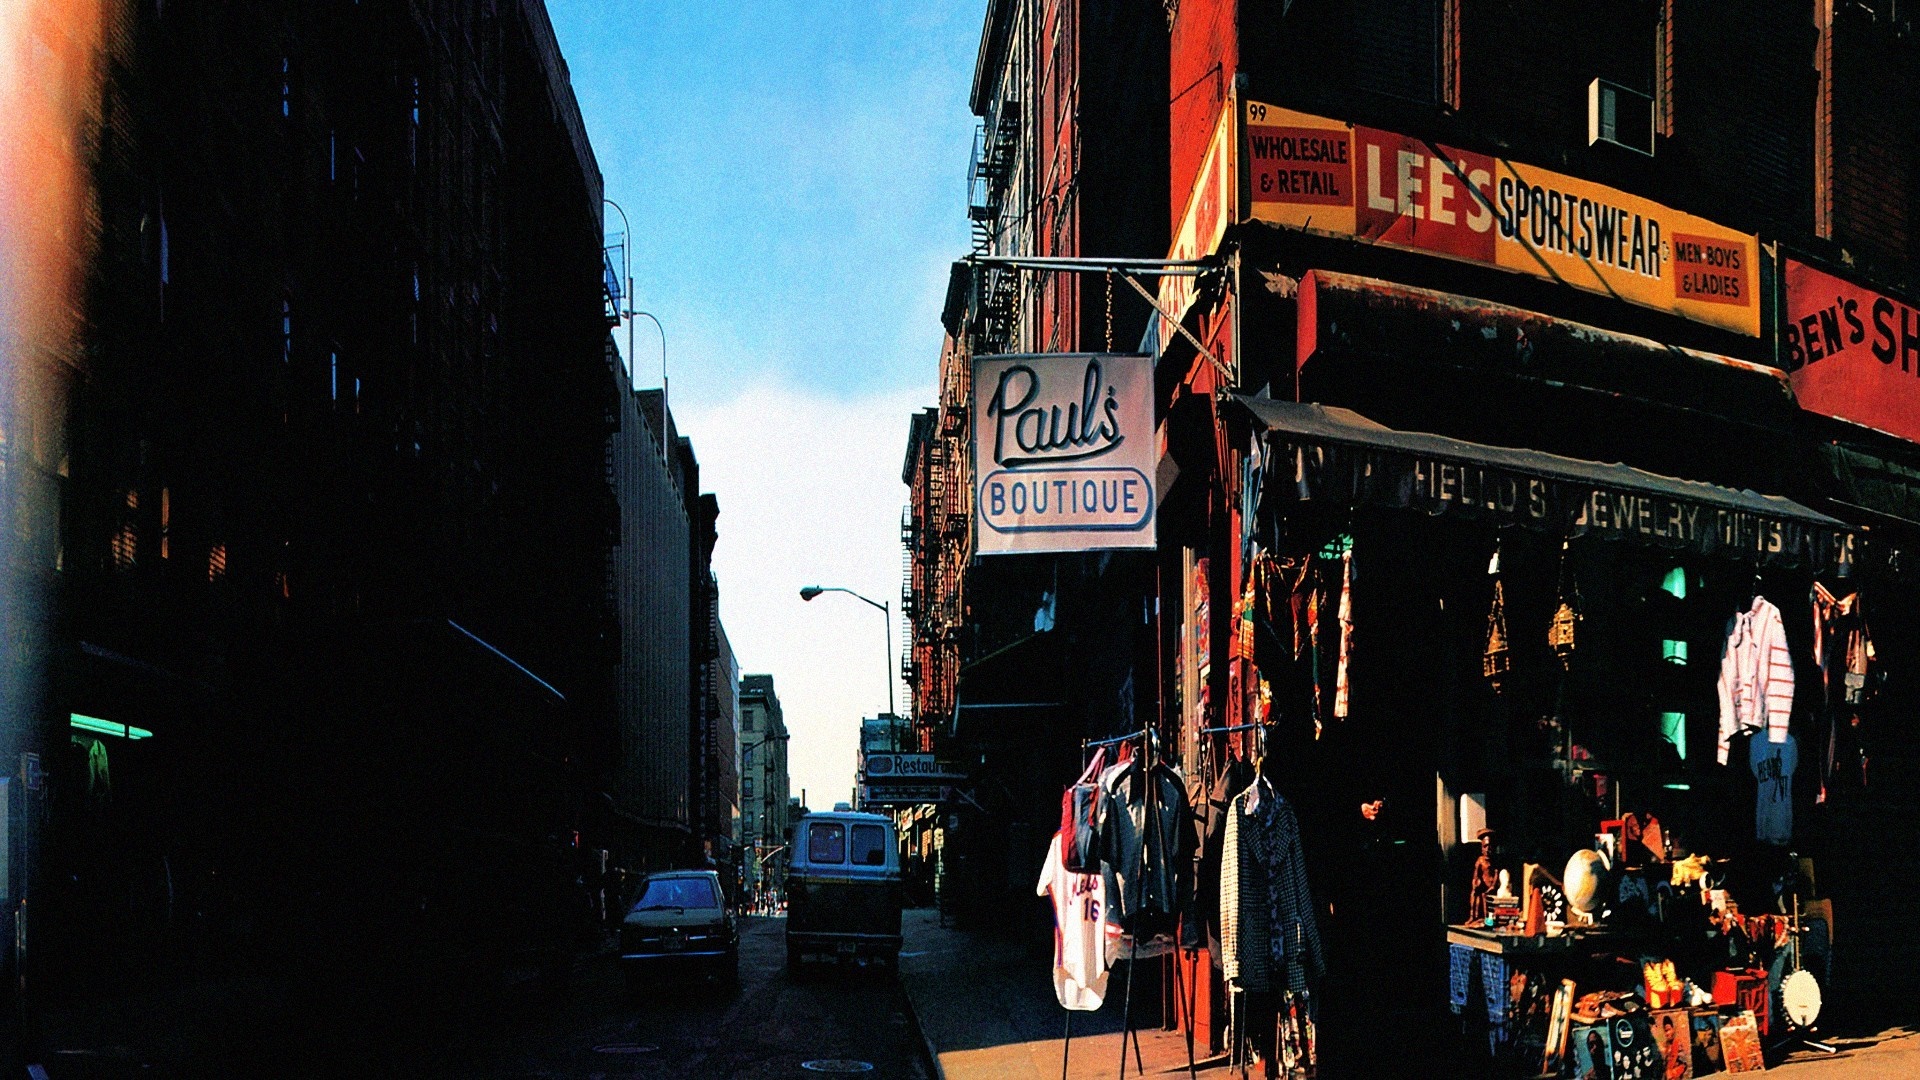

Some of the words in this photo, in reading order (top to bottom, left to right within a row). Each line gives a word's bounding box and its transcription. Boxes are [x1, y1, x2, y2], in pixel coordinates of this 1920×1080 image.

[1250, 104, 1266, 121] 99
[1252, 136, 1347, 164] WHOLESALE
[1261, 173, 1274, 193] &
[1278, 169, 1339, 195] RETAIL
[1367, 143, 1492, 233] LEE'S
[1500, 177, 1660, 281] SPORTSWEAR
[1675, 241, 1702, 264] MEN
[1707, 246, 1740, 270] BOYS
[1683, 274, 1692, 293] &
[1694, 273, 1740, 298] LADIES
[1786, 296, 1864, 373] BEN'S
[987, 357, 1125, 469] Paul's
[991, 480, 1139, 516] BOUTIQUE
[1085, 898, 1100, 922] 16
